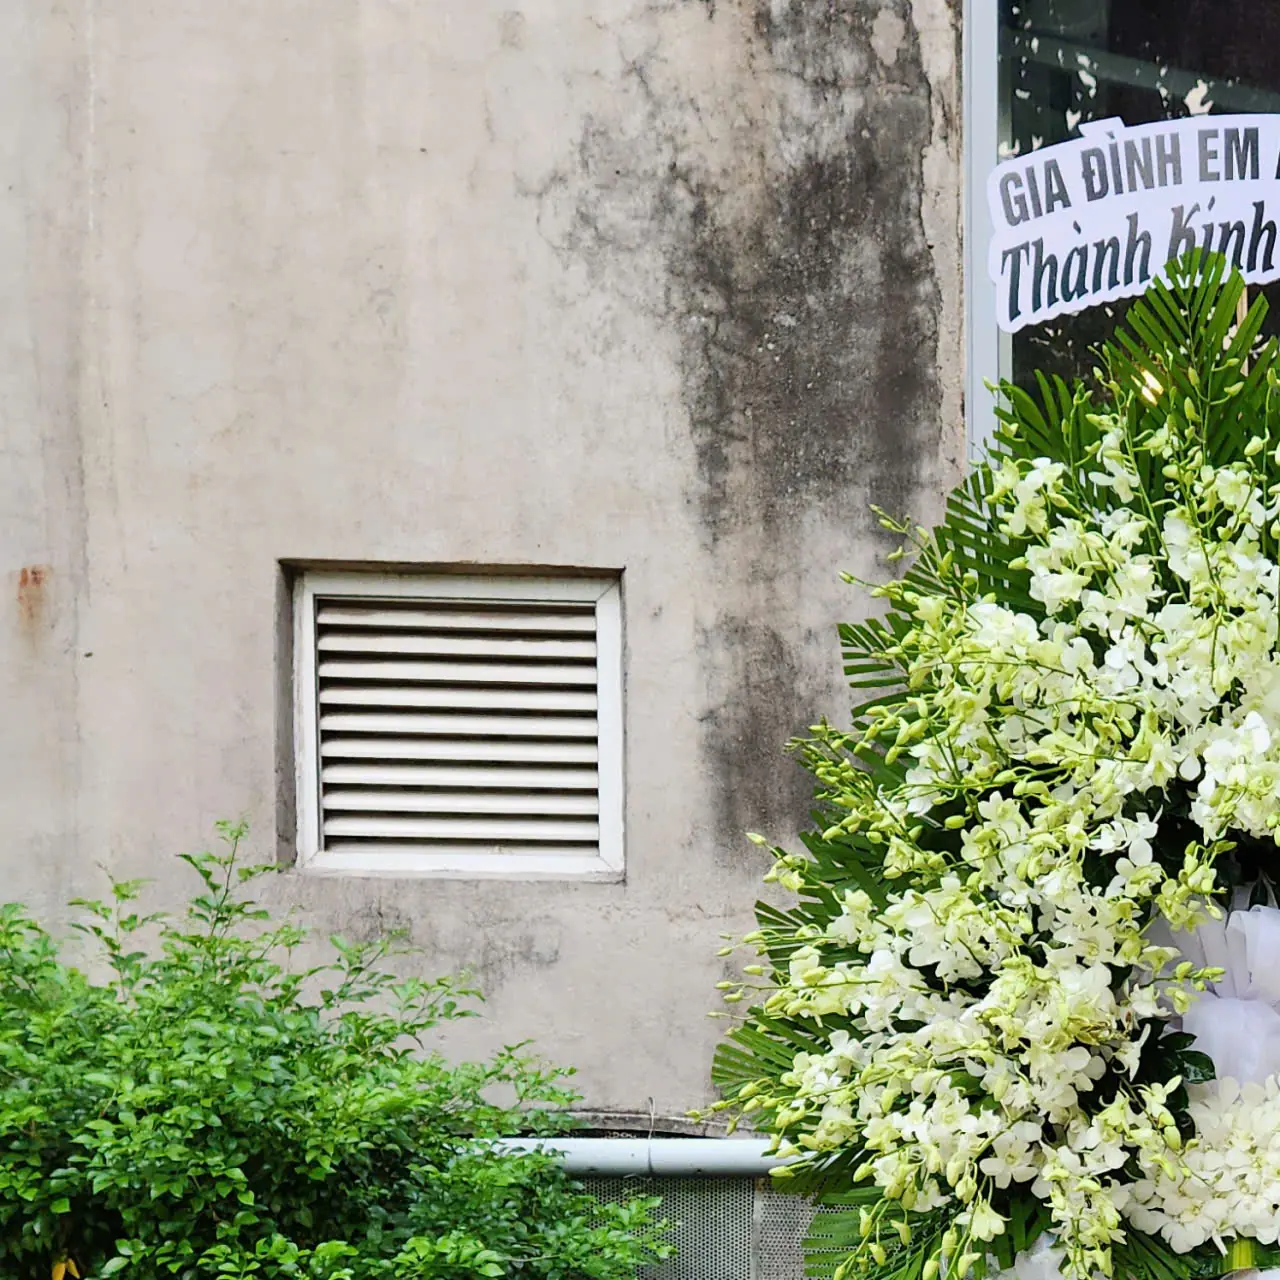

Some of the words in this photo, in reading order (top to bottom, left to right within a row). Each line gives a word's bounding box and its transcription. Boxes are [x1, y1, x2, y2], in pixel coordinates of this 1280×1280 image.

[999, 158, 1072, 227] GIA
[1080, 131, 1183, 203] ĐÌNH
[1197, 127, 1260, 182] EM
[1000, 212, 1151, 322] Thành
[1165, 195, 1278, 276] Kính
